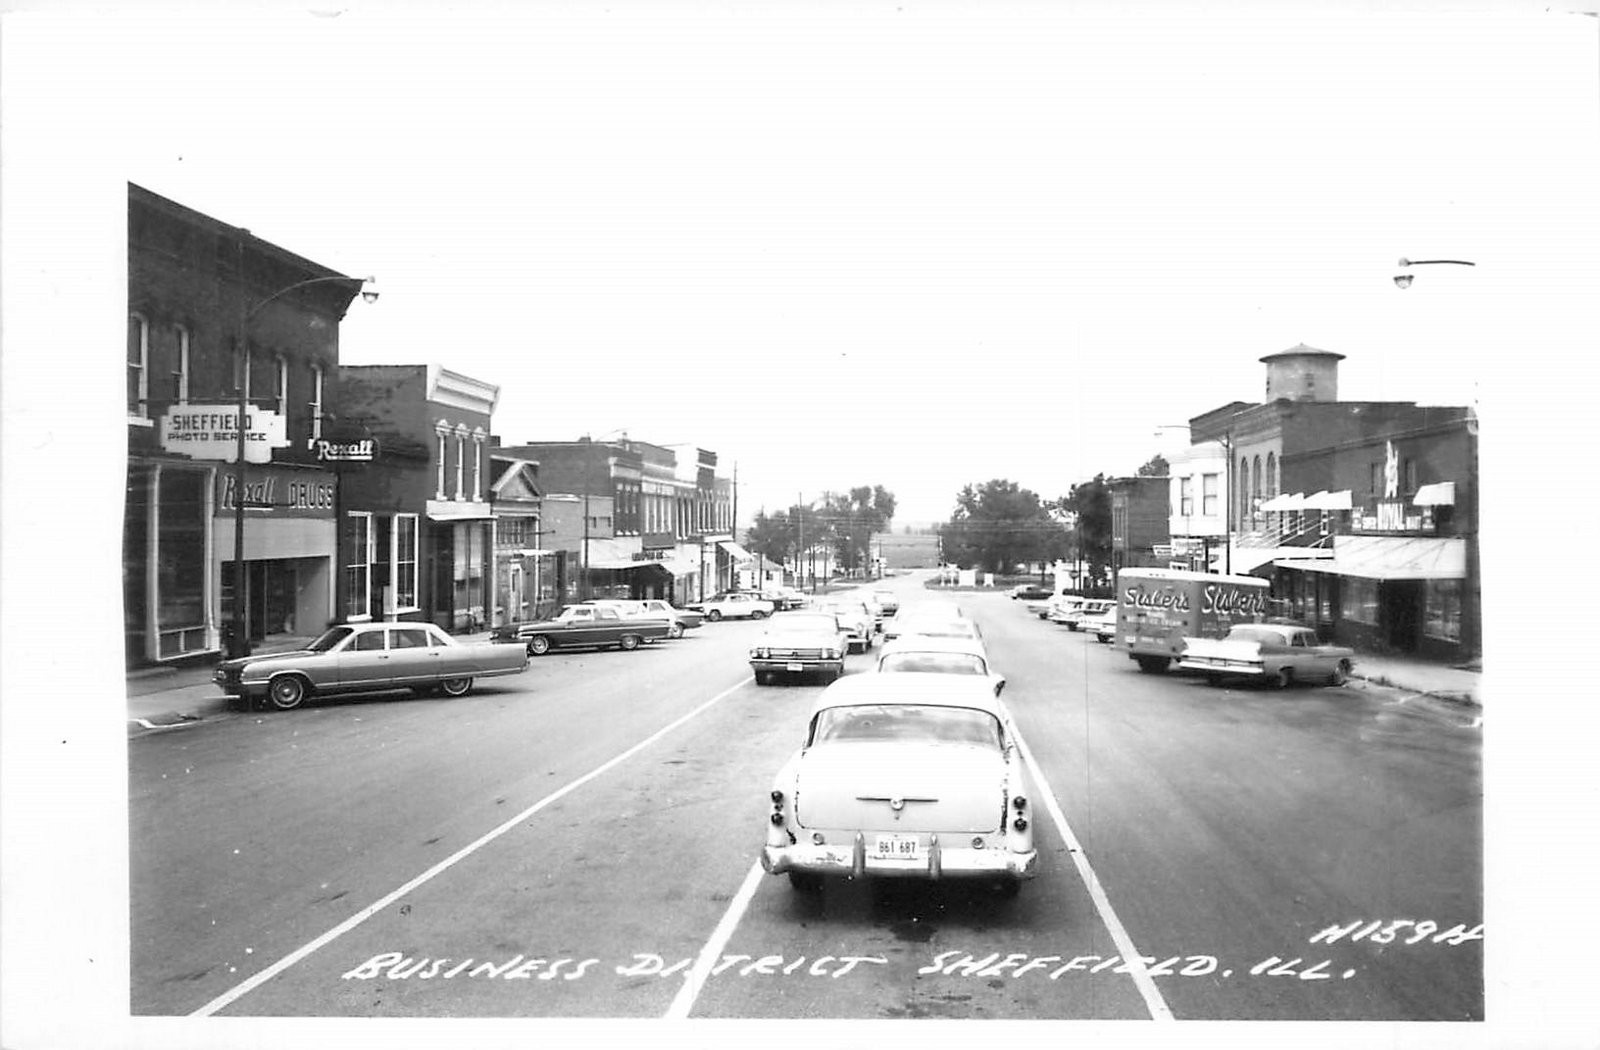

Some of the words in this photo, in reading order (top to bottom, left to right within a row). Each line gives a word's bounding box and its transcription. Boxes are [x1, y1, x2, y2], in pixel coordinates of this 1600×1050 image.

[172, 414, 252, 430] SHEFFIELD
[167, 432, 209, 441] PHOTO
[213, 432, 267, 441] SERICE
[317, 440, 374, 461] Rexall
[221, 474, 275, 510] Rxall
[288, 482, 334, 510] DRUGS
[900, 841, 916, 854] 687
